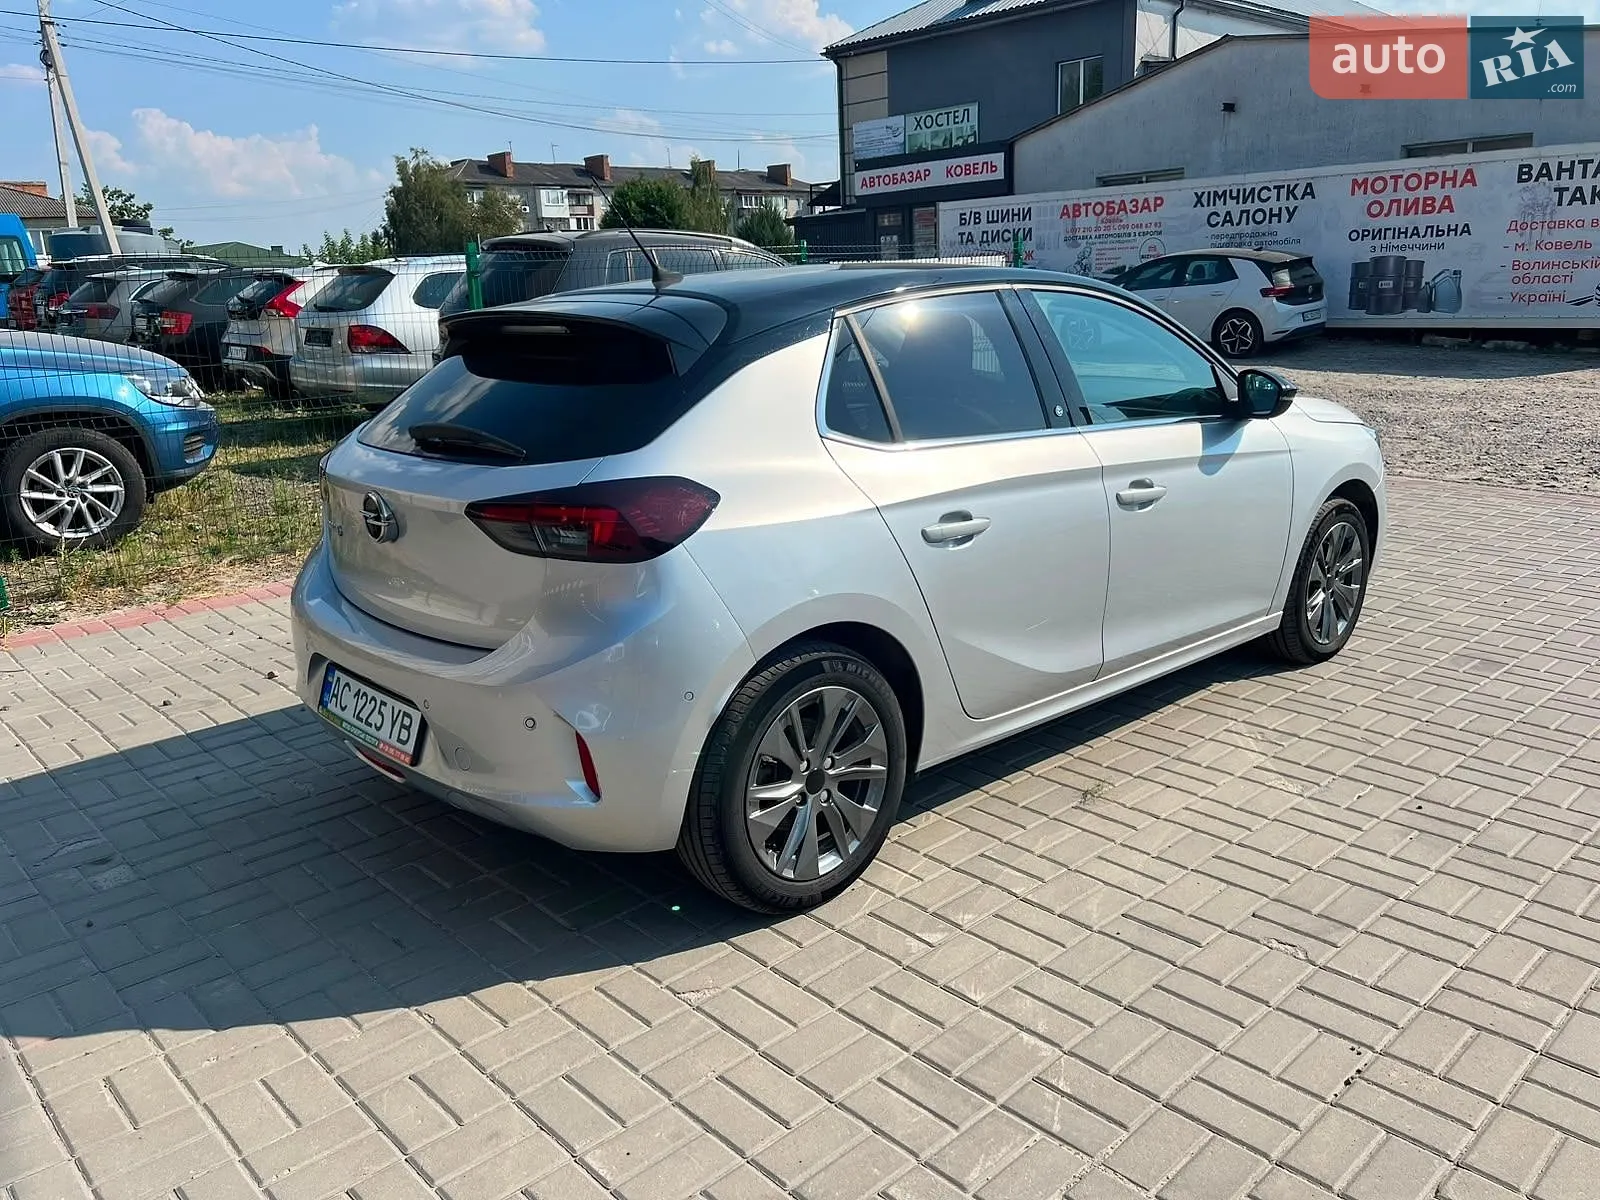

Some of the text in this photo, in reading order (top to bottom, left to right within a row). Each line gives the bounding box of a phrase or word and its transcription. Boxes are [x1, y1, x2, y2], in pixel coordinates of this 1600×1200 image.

[914, 108, 970, 131] ХОСТЕЛ
[860, 160, 998, 190] АВТОБАЗАР КОВЕЛЬ
[1350, 168, 1478, 196] МОТОРНА
[1193, 182, 1316, 208] ХІМЧИСТКА
[959, 206, 1032, 226] Б/В ШИНИ
[1060, 196, 1165, 219] АВТОБАЗАР
[1206, 205, 1299, 228] САЛОНУ
[1366, 194, 1455, 219] ОЛИВА
[1210, 230, 1278, 241] передпродажна
[1348, 222, 1472, 242] ОРИГІНАЛЬНА
[1506, 218, 1585, 233] Доставка
[958, 227, 1033, 247] ТА ДИСКИ
[1369, 241, 1445, 253] з Німеччини
[1535, 239, 1593, 251] Ковель
[1511, 271, 1574, 284] області
[1510, 290, 1567, 305] Україні
[329, 676, 352, 712] AC
[352, 688, 388, 732] 1225
[388, 705, 413, 746] YB
